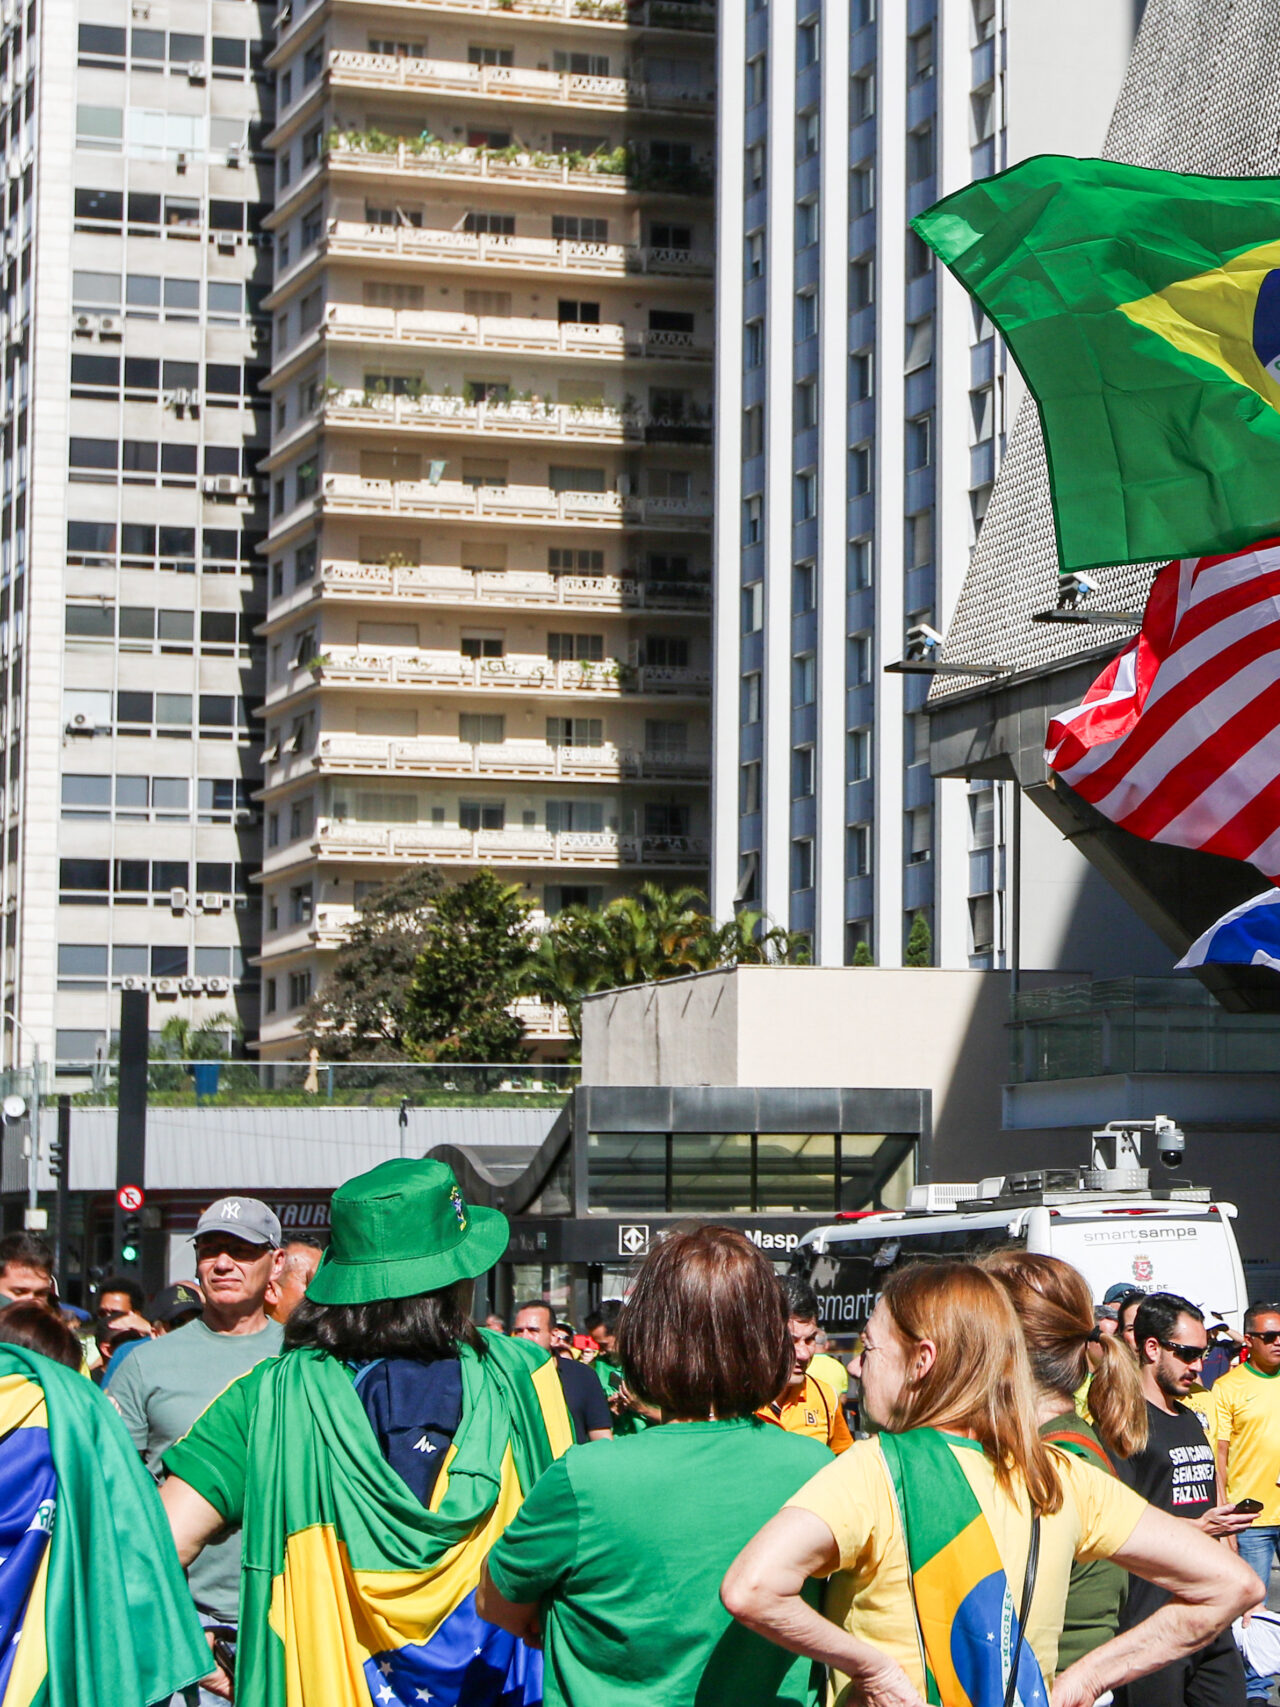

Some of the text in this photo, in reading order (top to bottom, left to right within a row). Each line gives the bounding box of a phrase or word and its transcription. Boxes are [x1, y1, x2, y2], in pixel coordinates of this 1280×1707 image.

[275, 1203, 331, 1226] TAUR
[745, 1230, 799, 1252] Masp
[1083, 1227, 1198, 1242] smartsampa
[1172, 1486, 1193, 1504] FAZ
